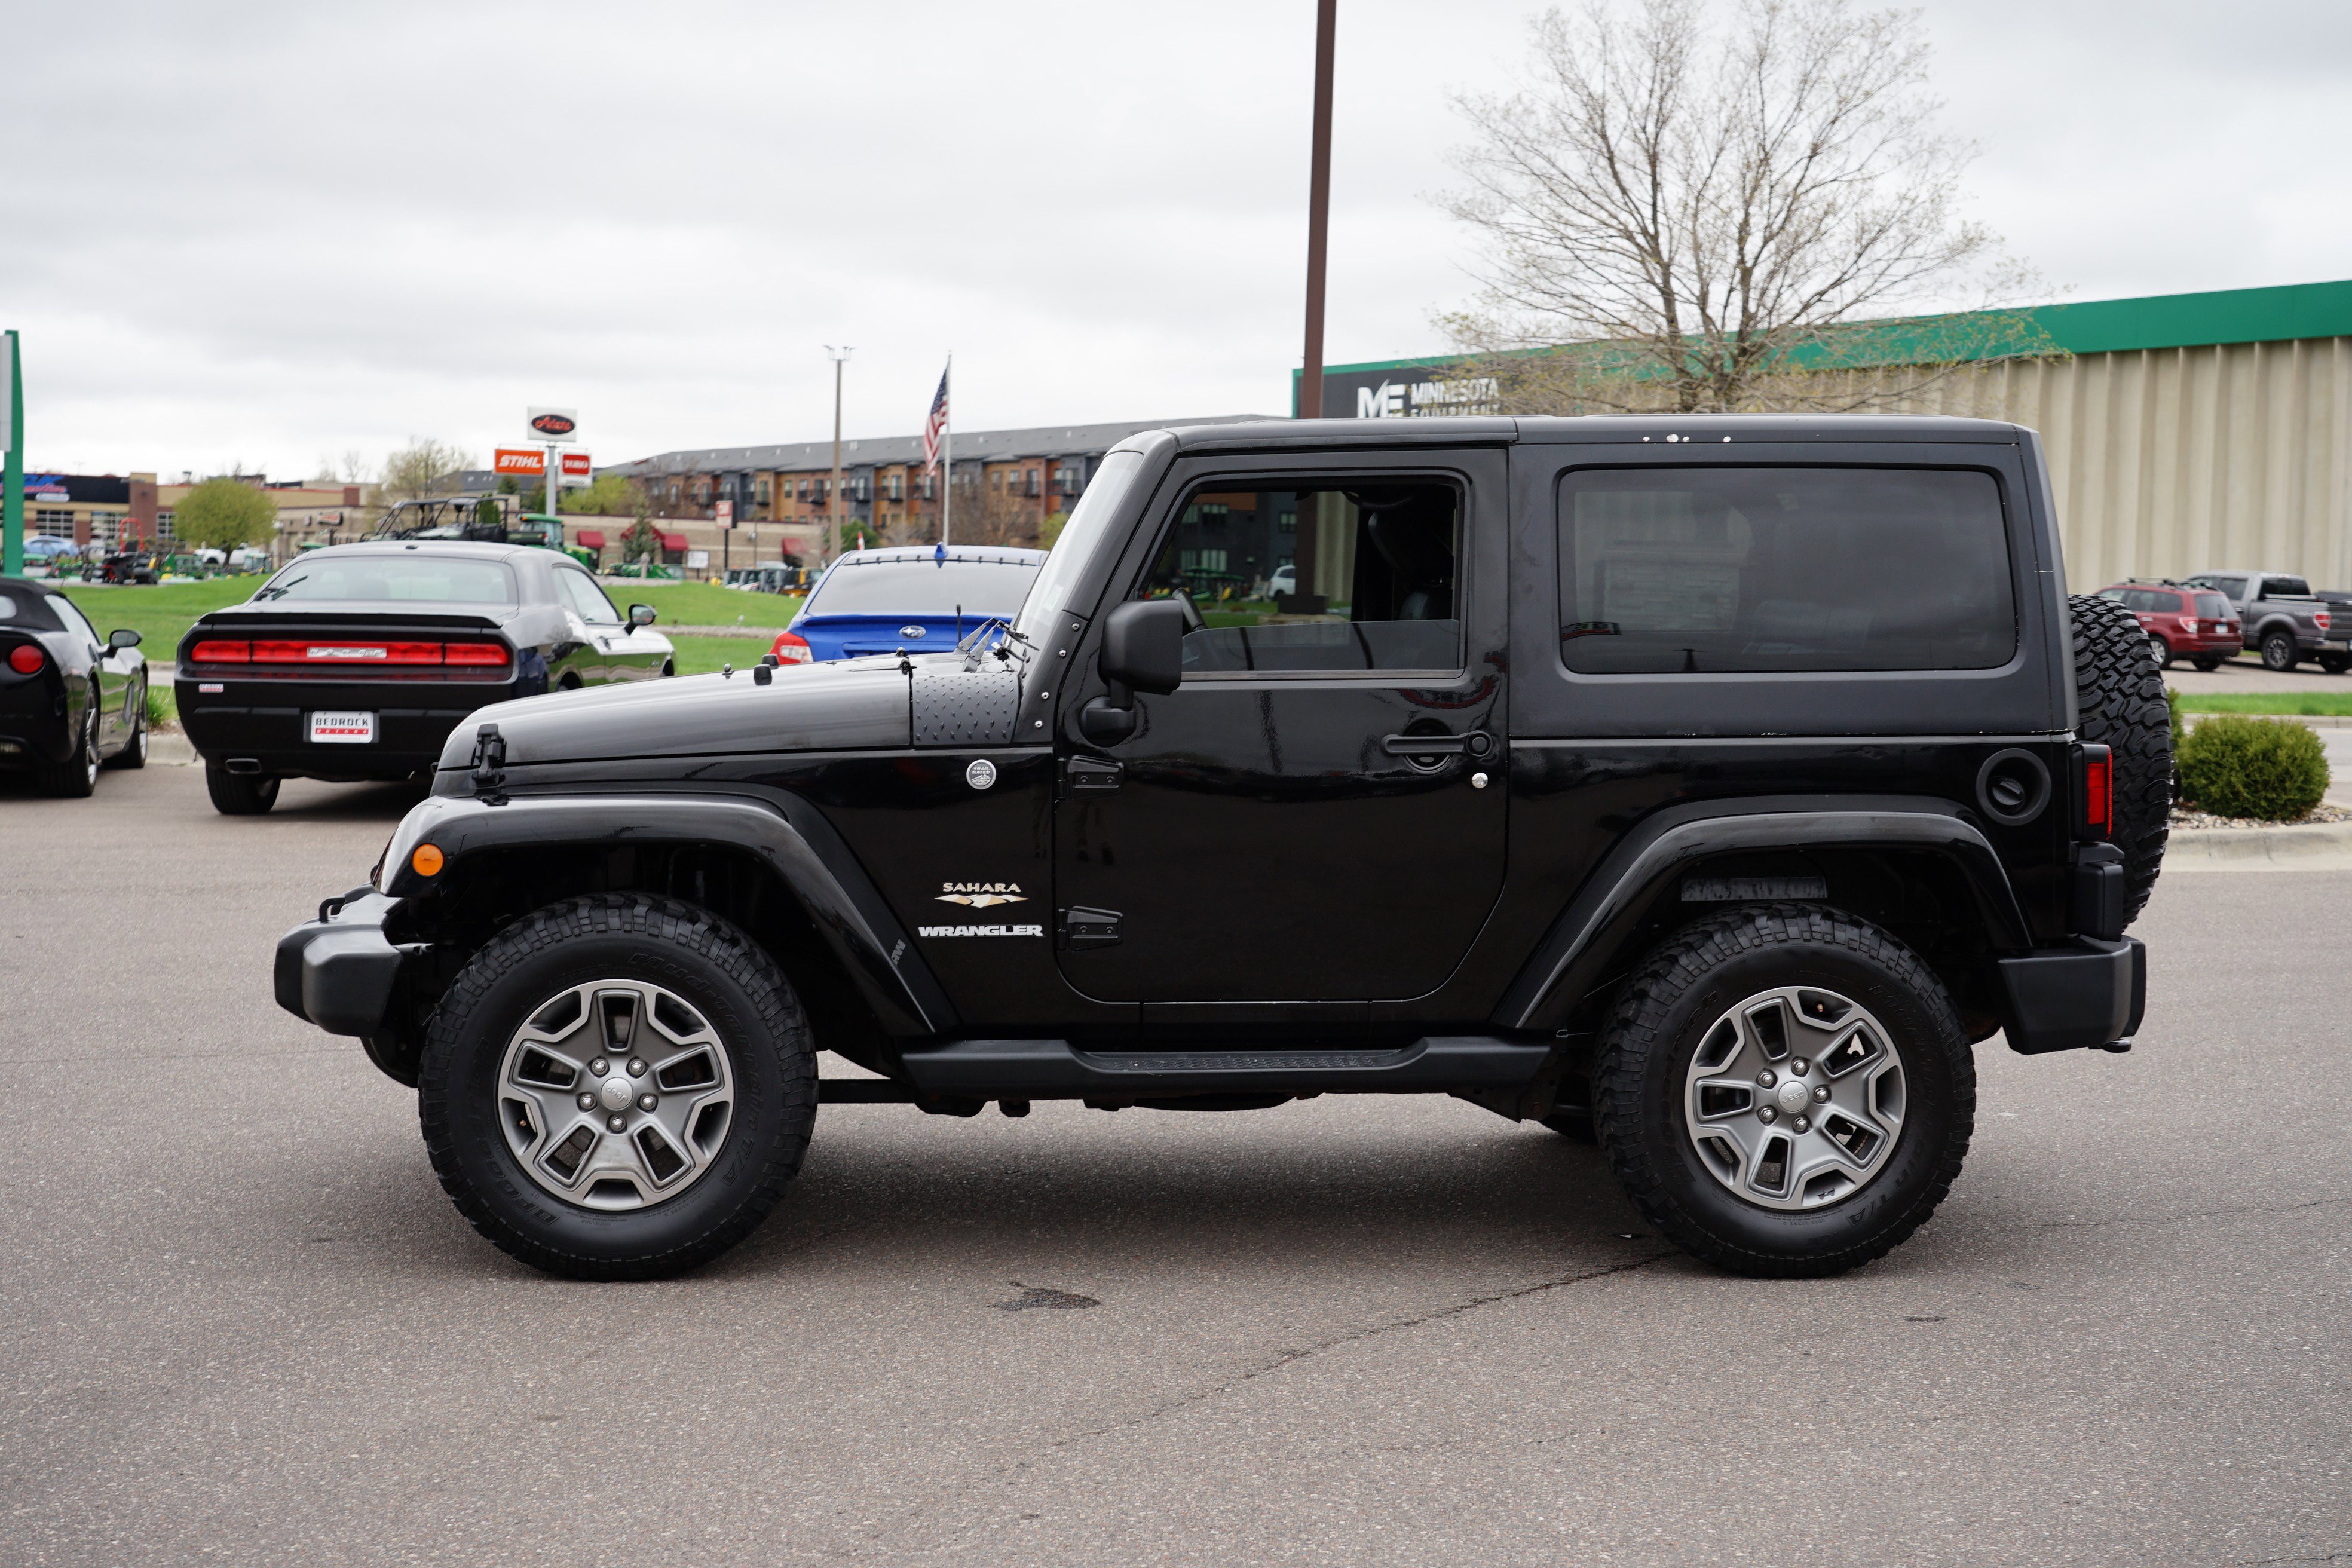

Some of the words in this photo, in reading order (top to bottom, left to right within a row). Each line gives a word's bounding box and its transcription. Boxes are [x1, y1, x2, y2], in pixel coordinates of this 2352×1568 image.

[1411, 378, 1500, 405] MINNESOTA
[498, 455, 541, 468] STIHL
[942, 883, 1021, 892] SAHARA
[918, 924, 1044, 937] WRANGLER
[606, 1085, 629, 1102] Jeep
[1781, 1090, 1804, 1102] Jeep
